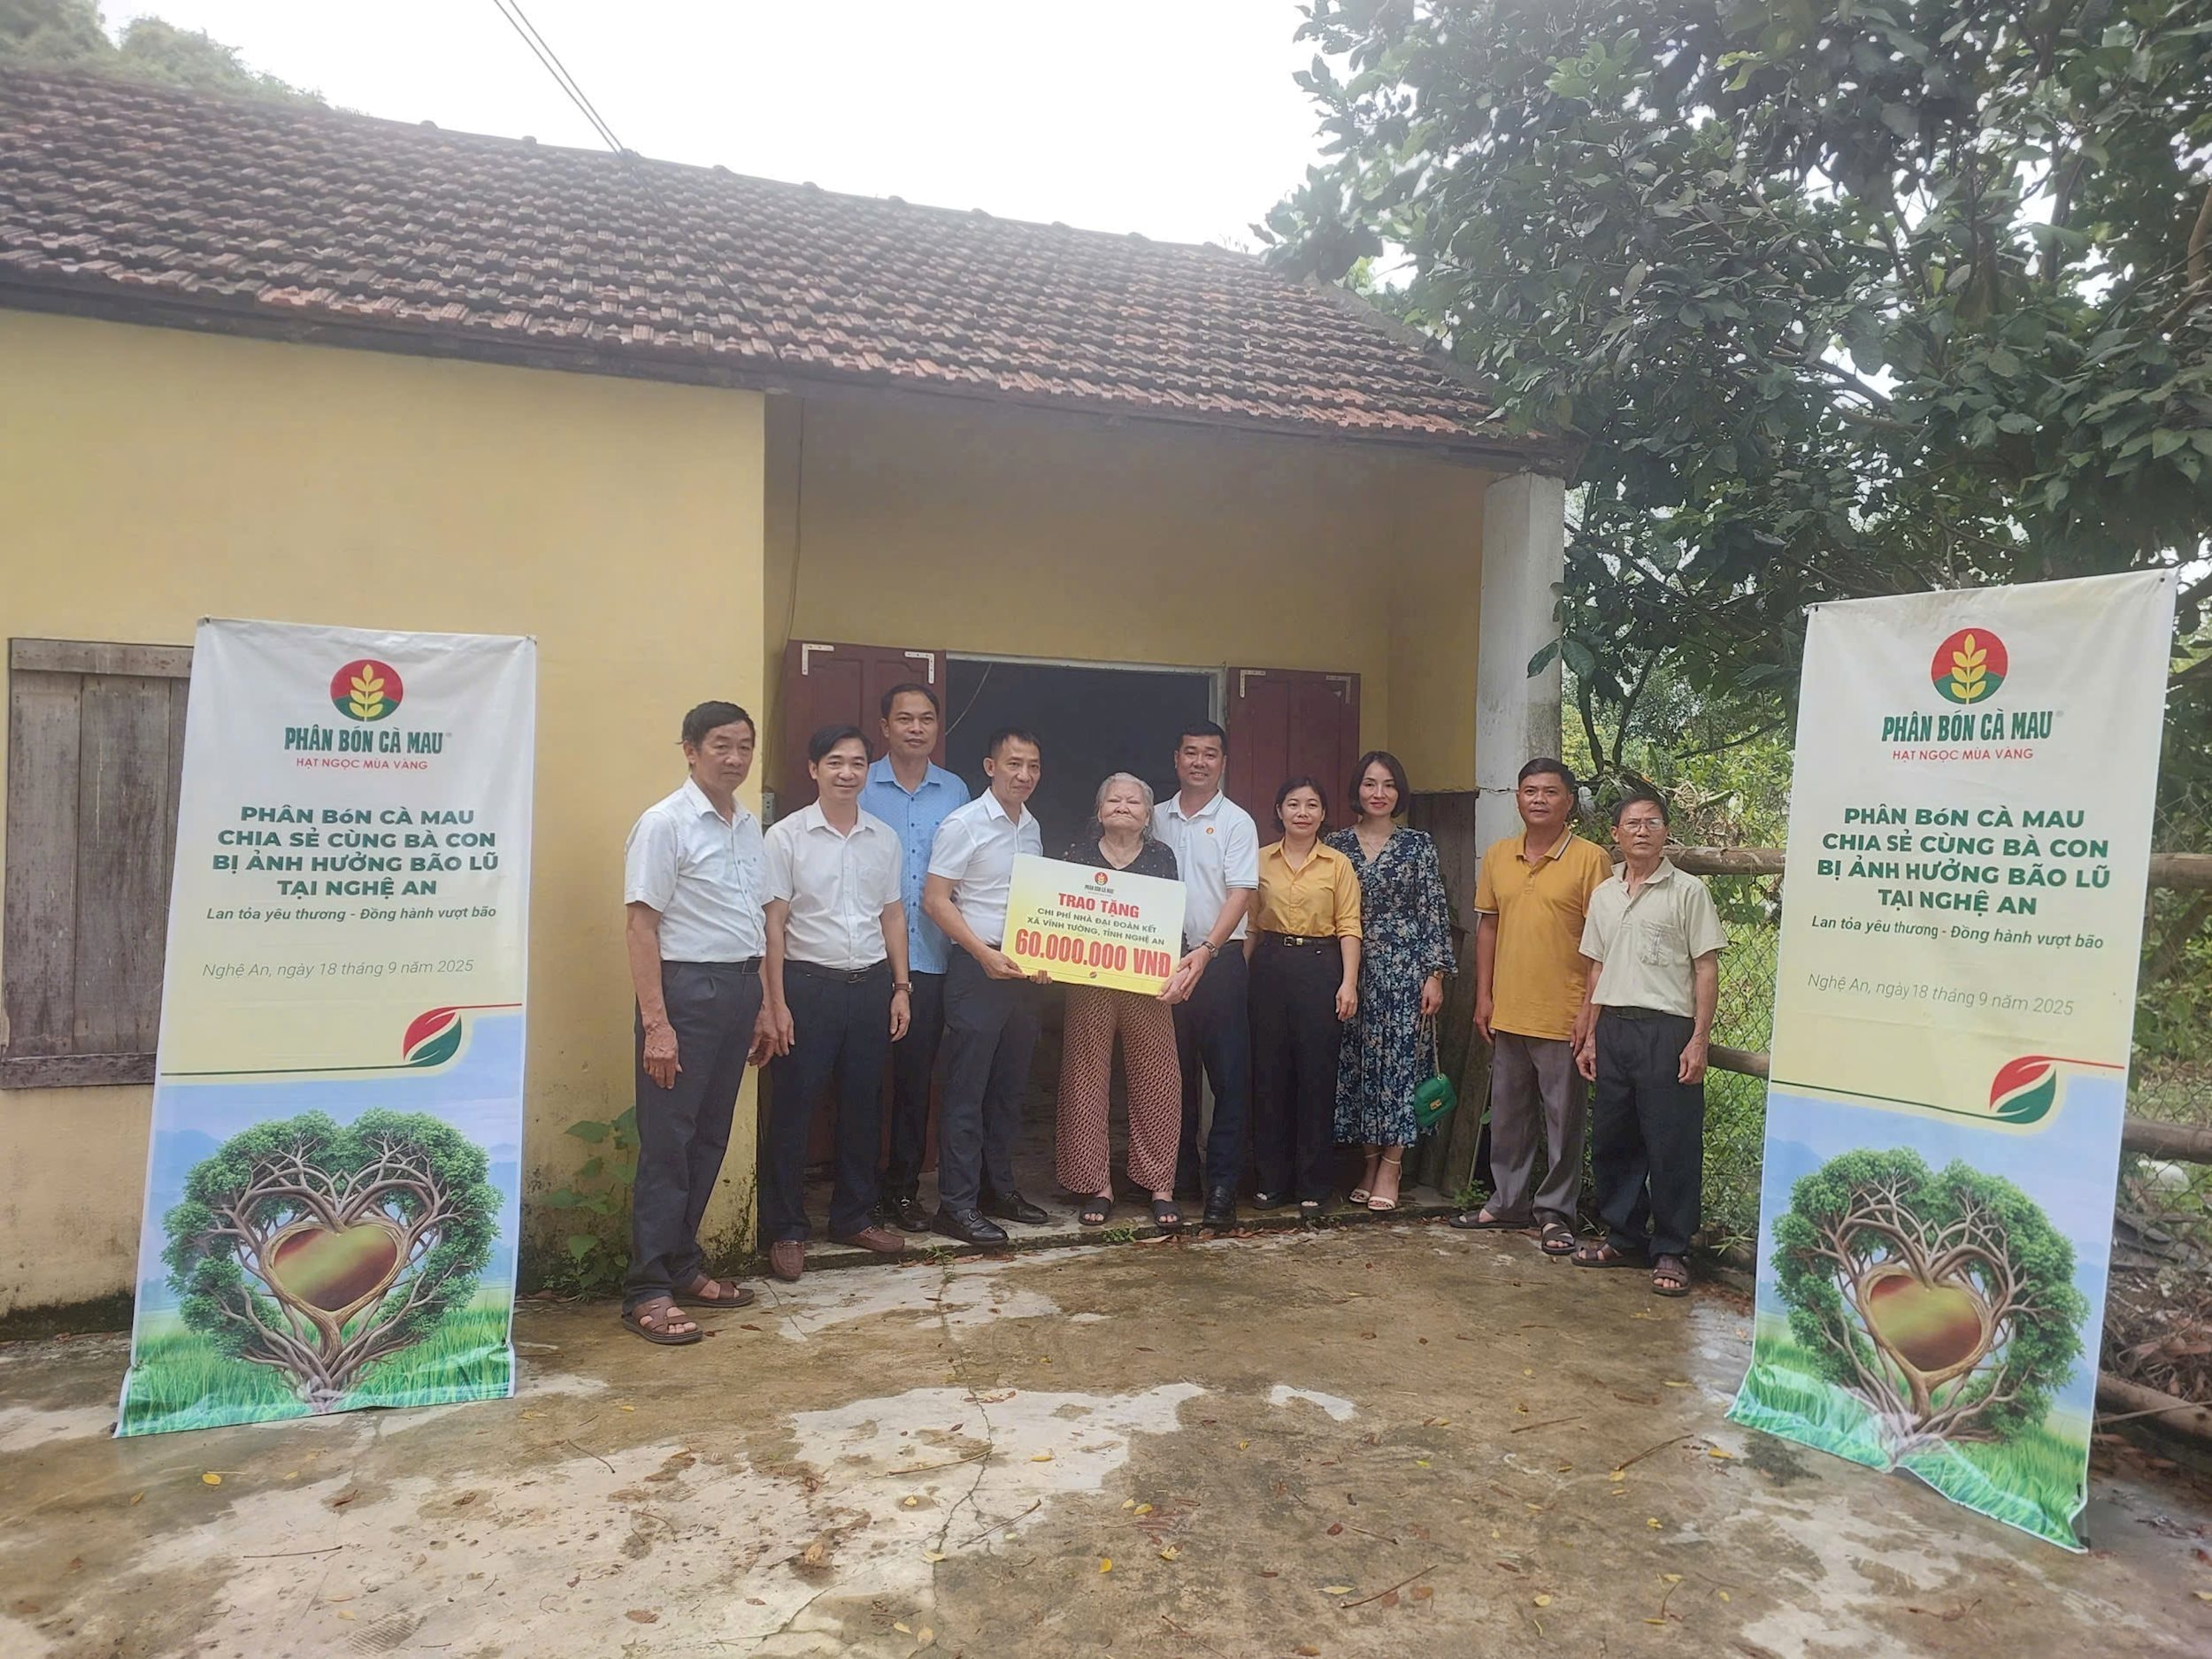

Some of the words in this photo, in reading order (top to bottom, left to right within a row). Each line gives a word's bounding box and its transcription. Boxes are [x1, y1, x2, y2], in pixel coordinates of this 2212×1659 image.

[1882, 711, 1932, 742] PHÂN
[1937, 709, 1976, 741] BÓN
[1980, 708, 2003, 741] CÀ
[2011, 711, 2054, 740] MAU
[284, 725, 334, 752] PHÂN
[338, 724, 373, 753] BÓN
[379, 728, 401, 754] CÀ
[407, 732, 443, 754] MAU
[296, 758, 319, 769] HẠT
[322, 758, 359, 771] NGỌC
[363, 757, 390, 770] MÙA
[393, 757, 428, 770] VÀNG
[1893, 749, 1916, 763] HẠT
[1919, 749, 1959, 763] NGỌC
[1962, 747, 1991, 760] MÙA
[1994, 747, 2033, 759] VÀNG
[241, 804, 313, 825] PHÂN
[380, 806, 412, 825] CÀ
[420, 810, 474, 825] MAU
[1844, 803, 1907, 825] PHÂN
[1977, 805, 2013, 827] CÀ
[2023, 810, 2084, 828] MAU
[218, 830, 280, 848] CHIA
[289, 827, 319, 848] SẺ
[327, 829, 396, 849] CÙNG
[404, 830, 438, 849] BÀ
[445, 832, 495, 848] CON
[1823, 833, 1881, 852] CHIA
[1886, 828, 1913, 852] SẺ
[1920, 833, 1994, 856] CÙNG
[2002, 834, 2041, 856] BÀ
[2049, 838, 2108, 858] CON
[212, 855, 238, 873] BỊ
[246, 849, 303, 871] ẢNH
[311, 852, 402, 872] HƯỞNG
[410, 853, 461, 872] BÃO
[469, 851, 498, 871] LŨ
[1816, 860, 1840, 881] BỊ
[1847, 855, 1899, 879] ẢNH
[1906, 859, 1999, 884] HƯỞNG
[2008, 864, 2066, 887] BÃO
[2076, 864, 2110, 888] LŨ
[277, 880, 317, 899] TẠI
[326, 877, 395, 899] NGHỆ
[402, 879, 437, 895] AN
[207, 908, 234, 920] Lan
[265, 908, 291, 922] yêu
[296, 908, 345, 922] thương
[360, 906, 396, 921] Đồng
[401, 906, 434, 919] hành
[438, 905, 468, 920] vượt
[472, 905, 496, 918] bão
[1059, 893, 1095, 910] TRAO
[1101, 900, 1139, 918] TẶNG
[1878, 888, 1913, 910] TẠI
[1919, 887, 1989, 916] NGHỆ
[1996, 895, 2036, 915] AN
[1056, 910, 1071, 919] PHÍ
[1095, 918, 1110, 926] ĐẠI
[1113, 918, 1139, 930] ĐOÀN
[1142, 923, 1157, 933] KẾT
[1811, 916, 1836, 930] Lan
[1865, 919, 1890, 934] yêu
[1893, 920, 1939, 939] thương
[1950, 924, 1990, 944] Đồng
[1993, 928, 2032, 944] hành
[2036, 932, 2070, 949] vượt
[2075, 933, 2103, 949] bão
[1125, 933, 1149, 944] NGHỆ
[1015, 928, 1126, 971] 60.000.000
[1133, 949, 1171, 978] VNĐ
[203, 963, 244, 979] Nghệ
[248, 964, 273, 978] An,
[277, 962, 314, 979] ngày
[319, 963, 337, 974] 18
[341, 961, 382, 978] tháng
[388, 962, 396, 973] 9
[400, 961, 433, 973] năm
[437, 959, 474, 972] 2025
[1808, 974, 1846, 992] Nghệ
[1849, 977, 1871, 995] An,
[1876, 981, 1909, 999] ngày
[1912, 984, 1928, 998] 18
[1932, 986, 1975, 1008] tháng
[1978, 992, 1988, 1007] 9
[1992, 994, 2029, 1010] năm
[2033, 997, 2074, 1016] 2025
